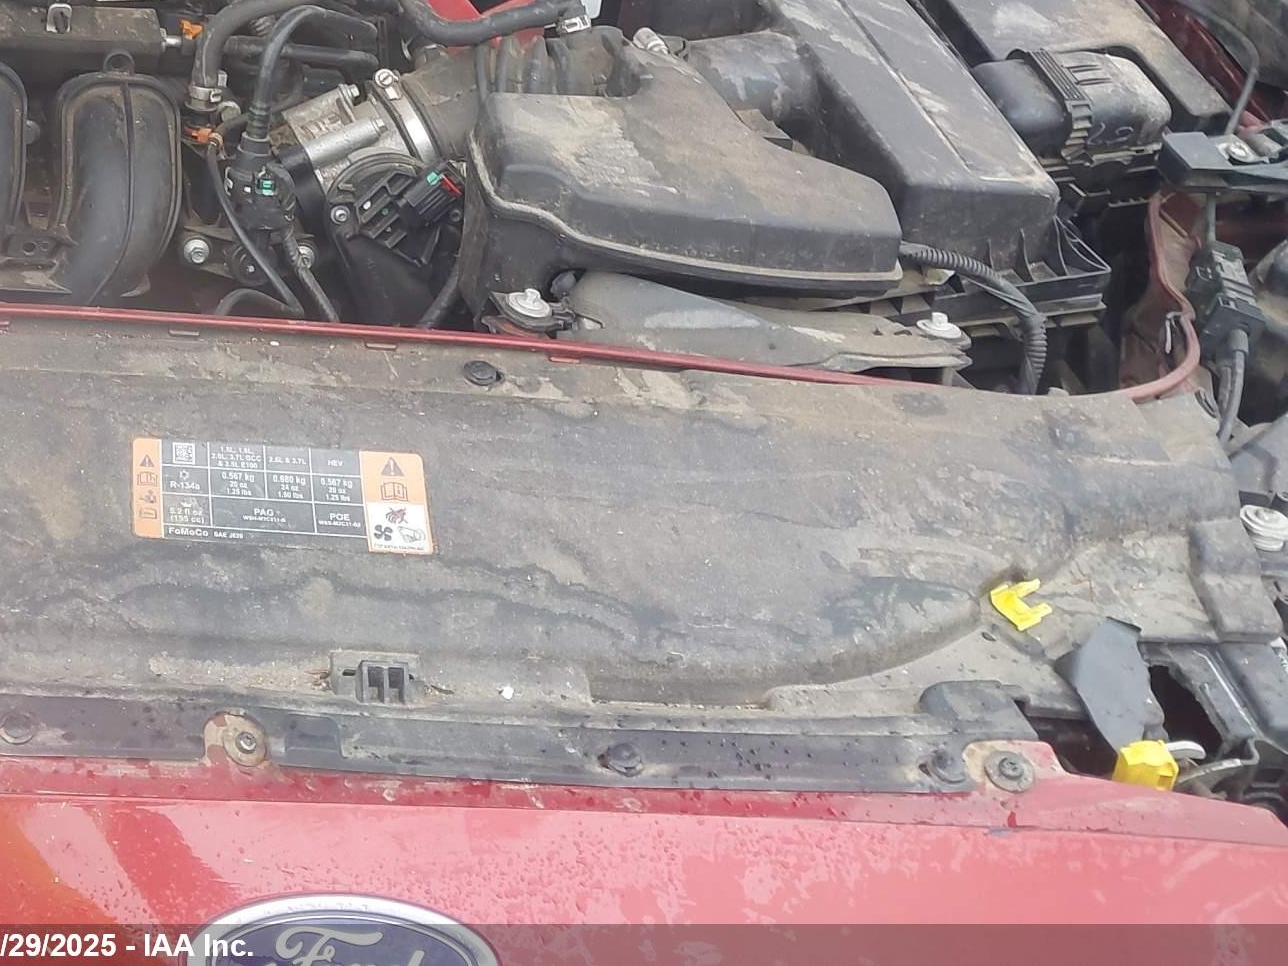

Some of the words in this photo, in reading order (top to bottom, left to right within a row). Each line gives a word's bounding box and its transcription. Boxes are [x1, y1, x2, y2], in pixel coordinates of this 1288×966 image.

[244, 472, 255, 483] kg
[295, 475, 306, 485] kg
[169, 480, 200, 490] R-134a
[329, 512, 351, 521] POE
[168, 527, 209, 537] FoMoCo
